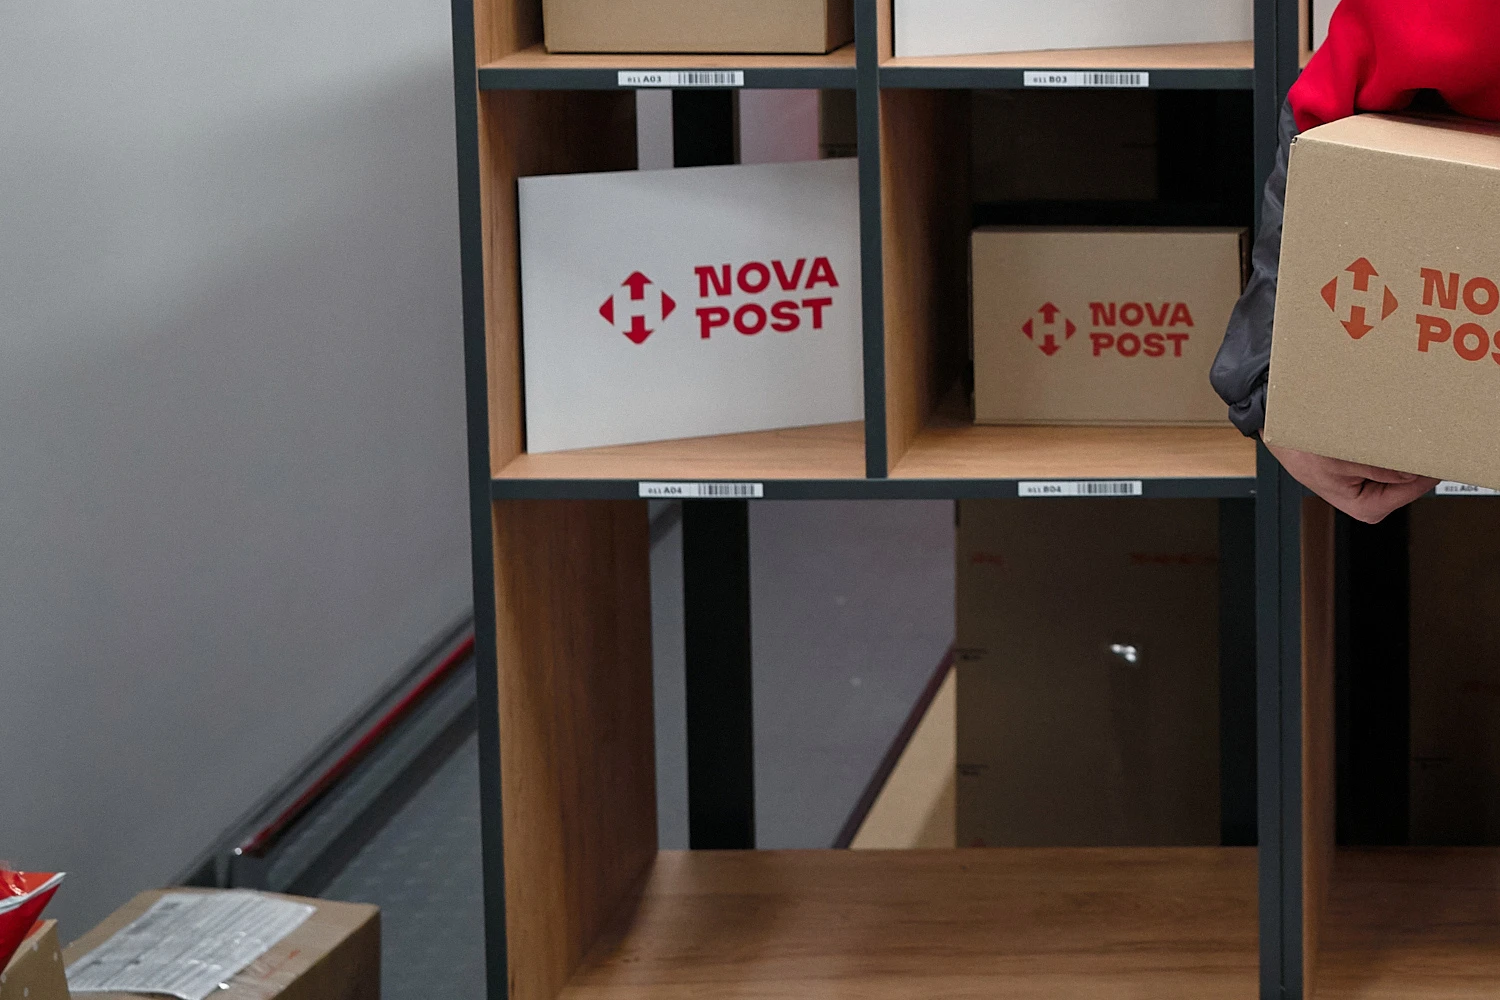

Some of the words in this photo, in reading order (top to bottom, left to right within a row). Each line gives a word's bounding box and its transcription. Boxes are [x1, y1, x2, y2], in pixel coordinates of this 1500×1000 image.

[695, 257, 839, 297] NOVA
[696, 297, 832, 339] POST
[1090, 302, 1194, 328] NOVA
[1090, 333, 1190, 358] POST
[664, 486, 682, 494] A04
